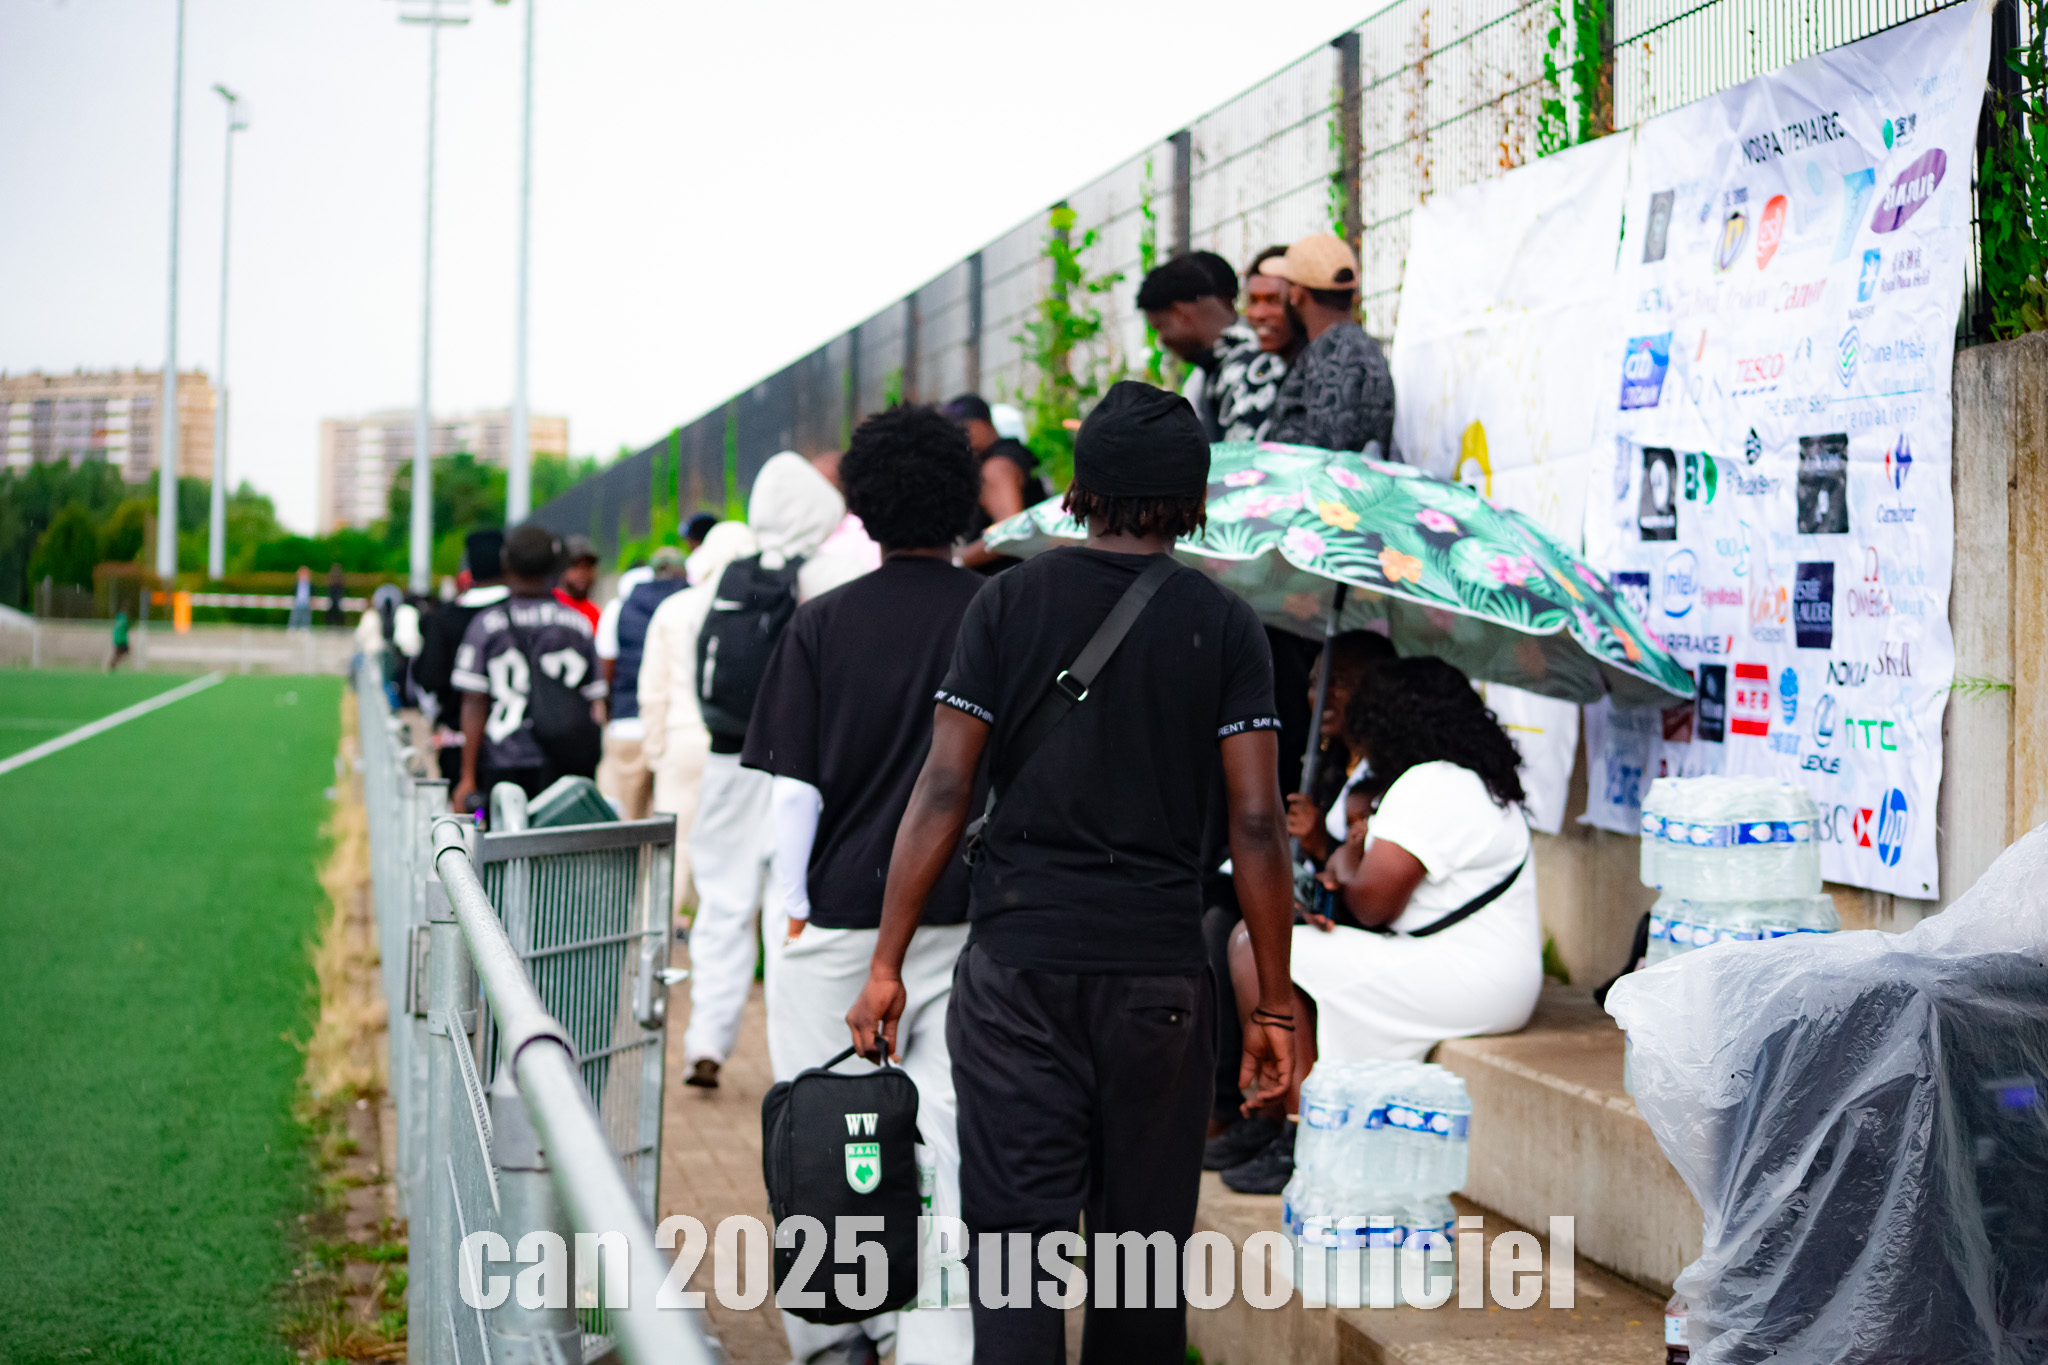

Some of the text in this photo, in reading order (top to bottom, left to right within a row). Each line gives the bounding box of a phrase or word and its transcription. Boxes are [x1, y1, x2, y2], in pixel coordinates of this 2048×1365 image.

[1737, 353, 1784, 383] TESCO
[1252, 717, 1271, 728] SAY
[845, 1113, 878, 1136] WW
